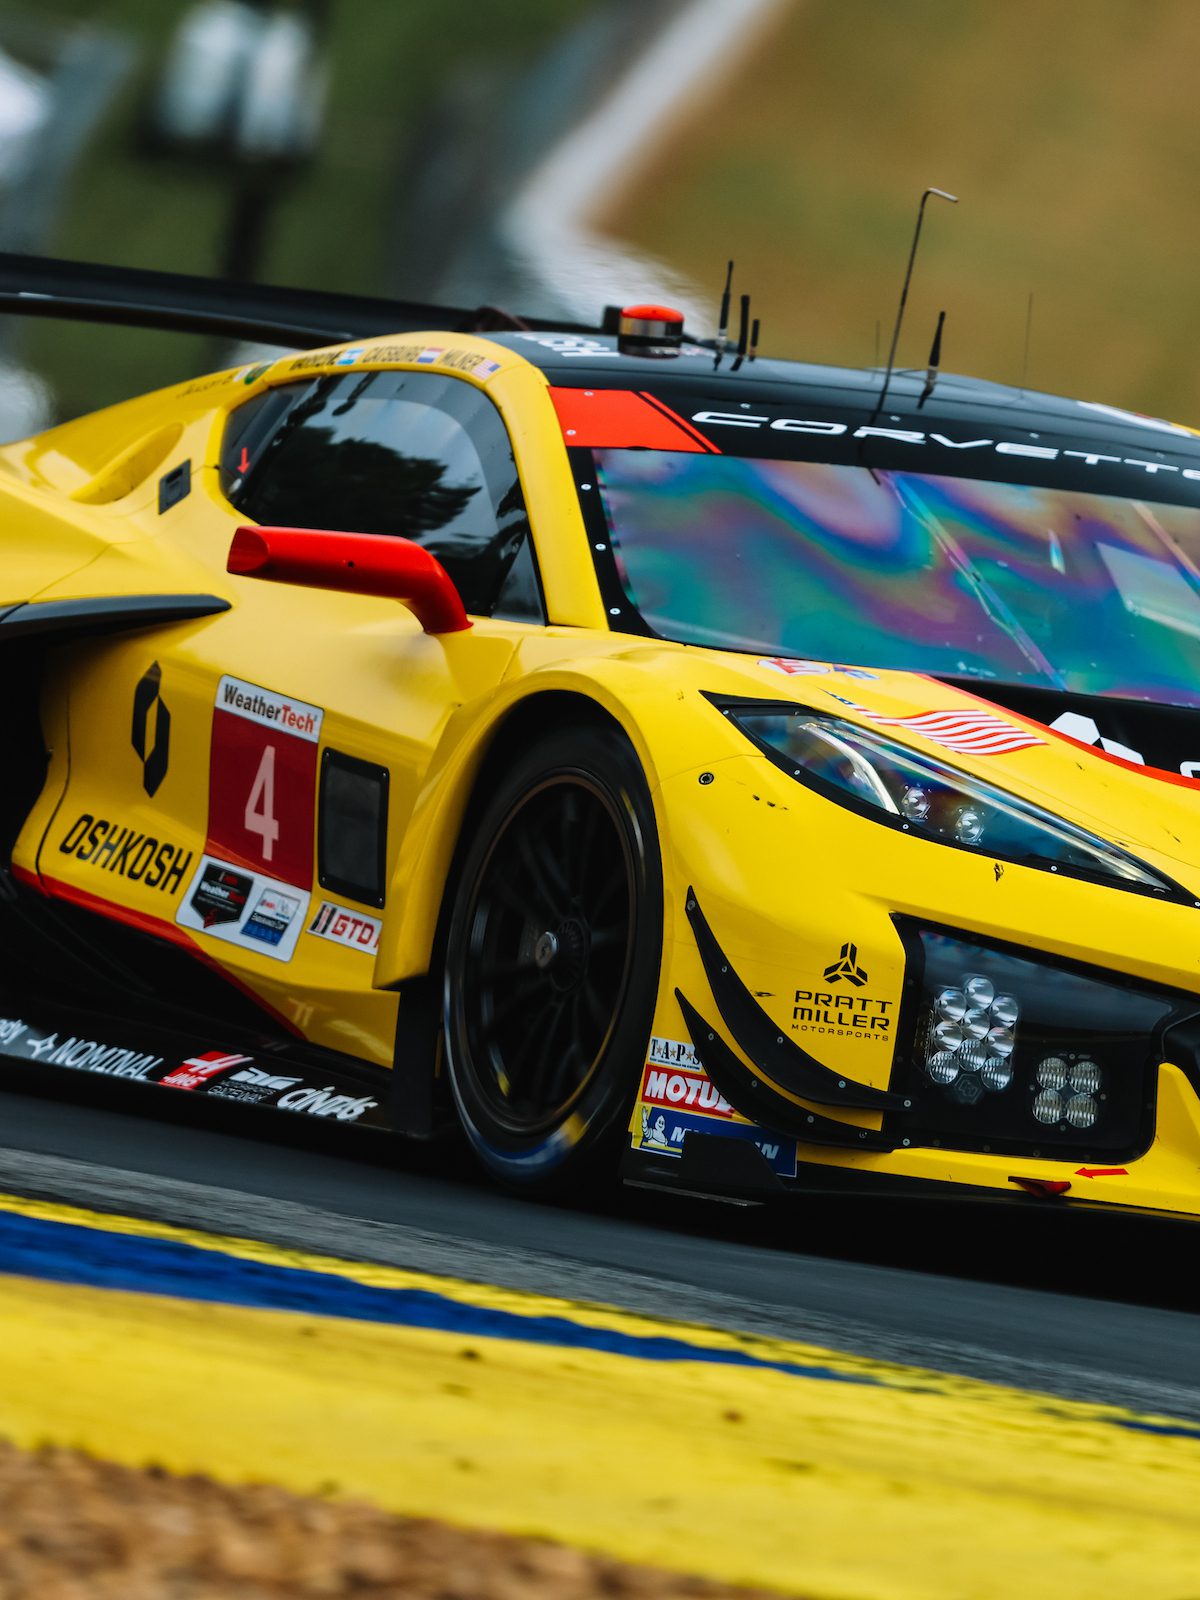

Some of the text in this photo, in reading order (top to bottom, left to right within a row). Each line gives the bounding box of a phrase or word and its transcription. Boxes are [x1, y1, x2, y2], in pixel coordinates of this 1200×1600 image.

[223, 683, 315, 734] WeatherTech
[244, 744, 279, 862] 4
[59, 814, 194, 895] OSHKOSH
[330, 913, 375, 945] GTD
[793, 1006, 890, 1031] MILLER
[795, 990, 893, 1014] PRATT
[791, 1024, 889, 1041] MOTORSPORTS
[48, 1036, 165, 1080] NOMINAL
